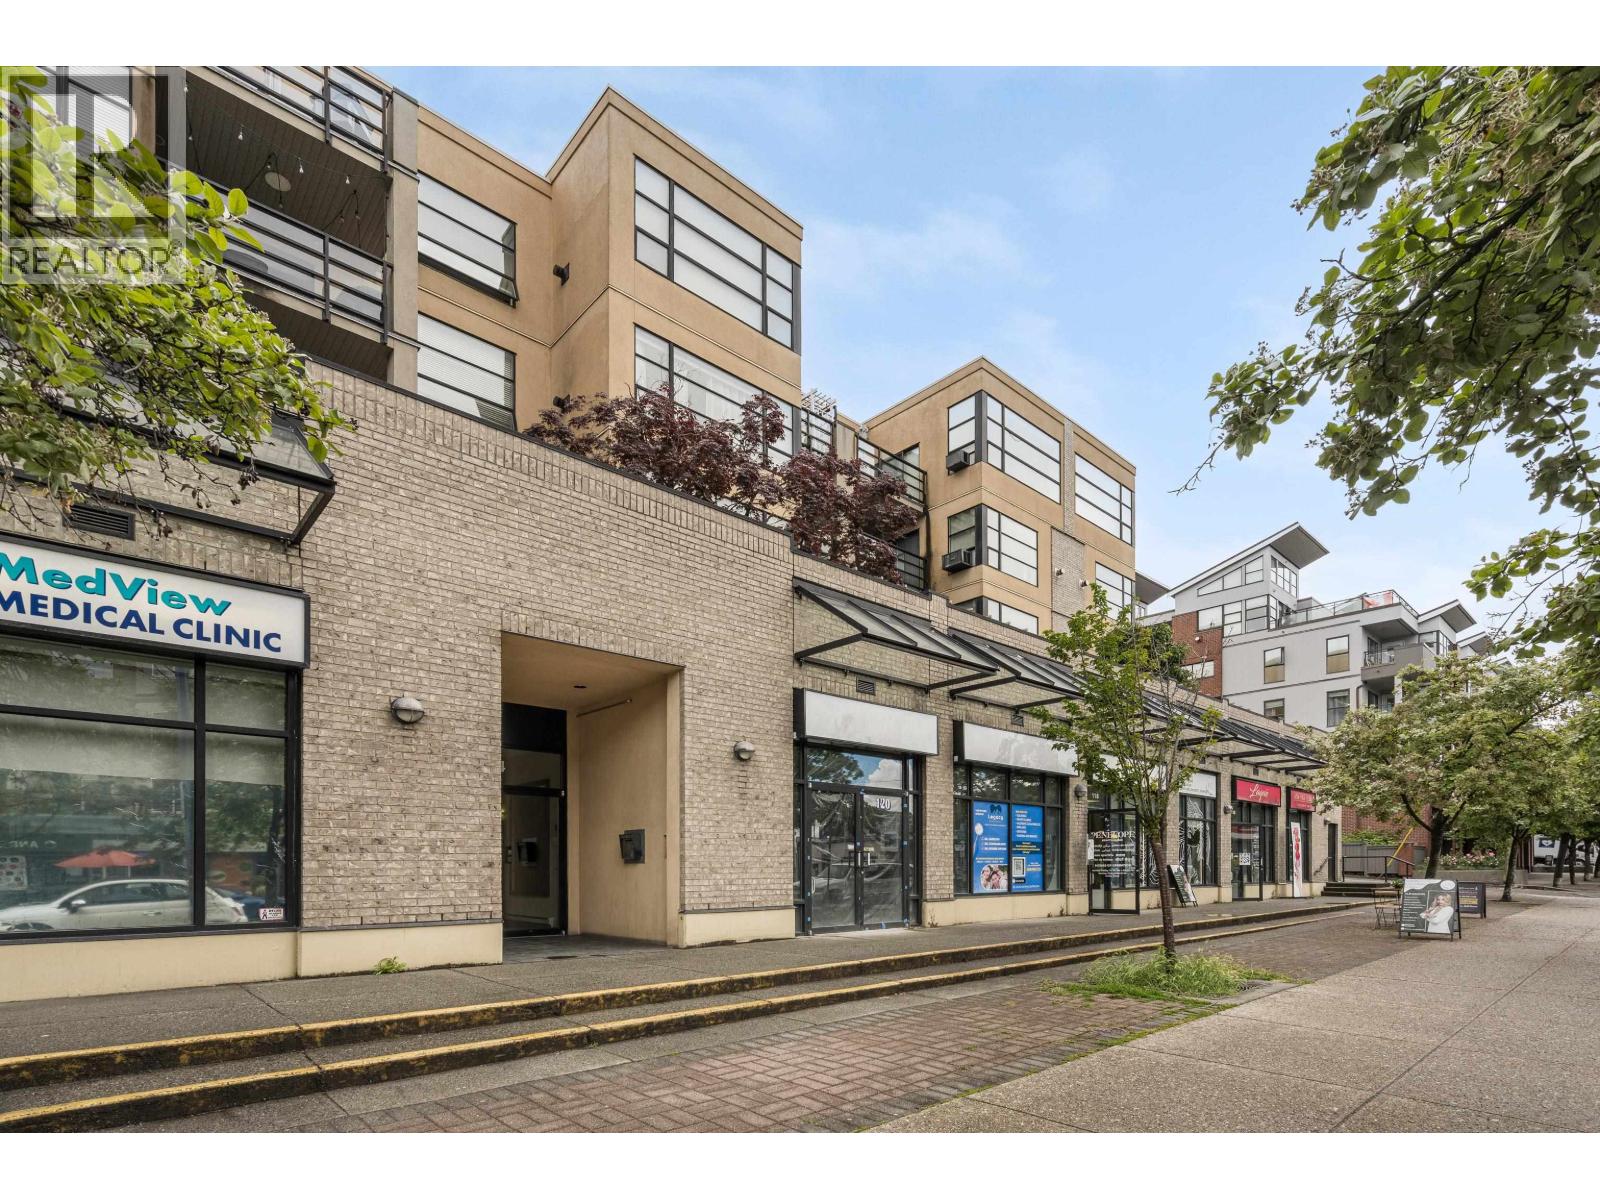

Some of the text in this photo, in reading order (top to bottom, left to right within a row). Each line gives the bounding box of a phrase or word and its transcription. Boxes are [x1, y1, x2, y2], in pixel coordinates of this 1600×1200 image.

[0, 553, 232, 616] MedView
[0, 590, 282, 652] MEDICAL CLINIC
[876, 797, 892, 810] 120
